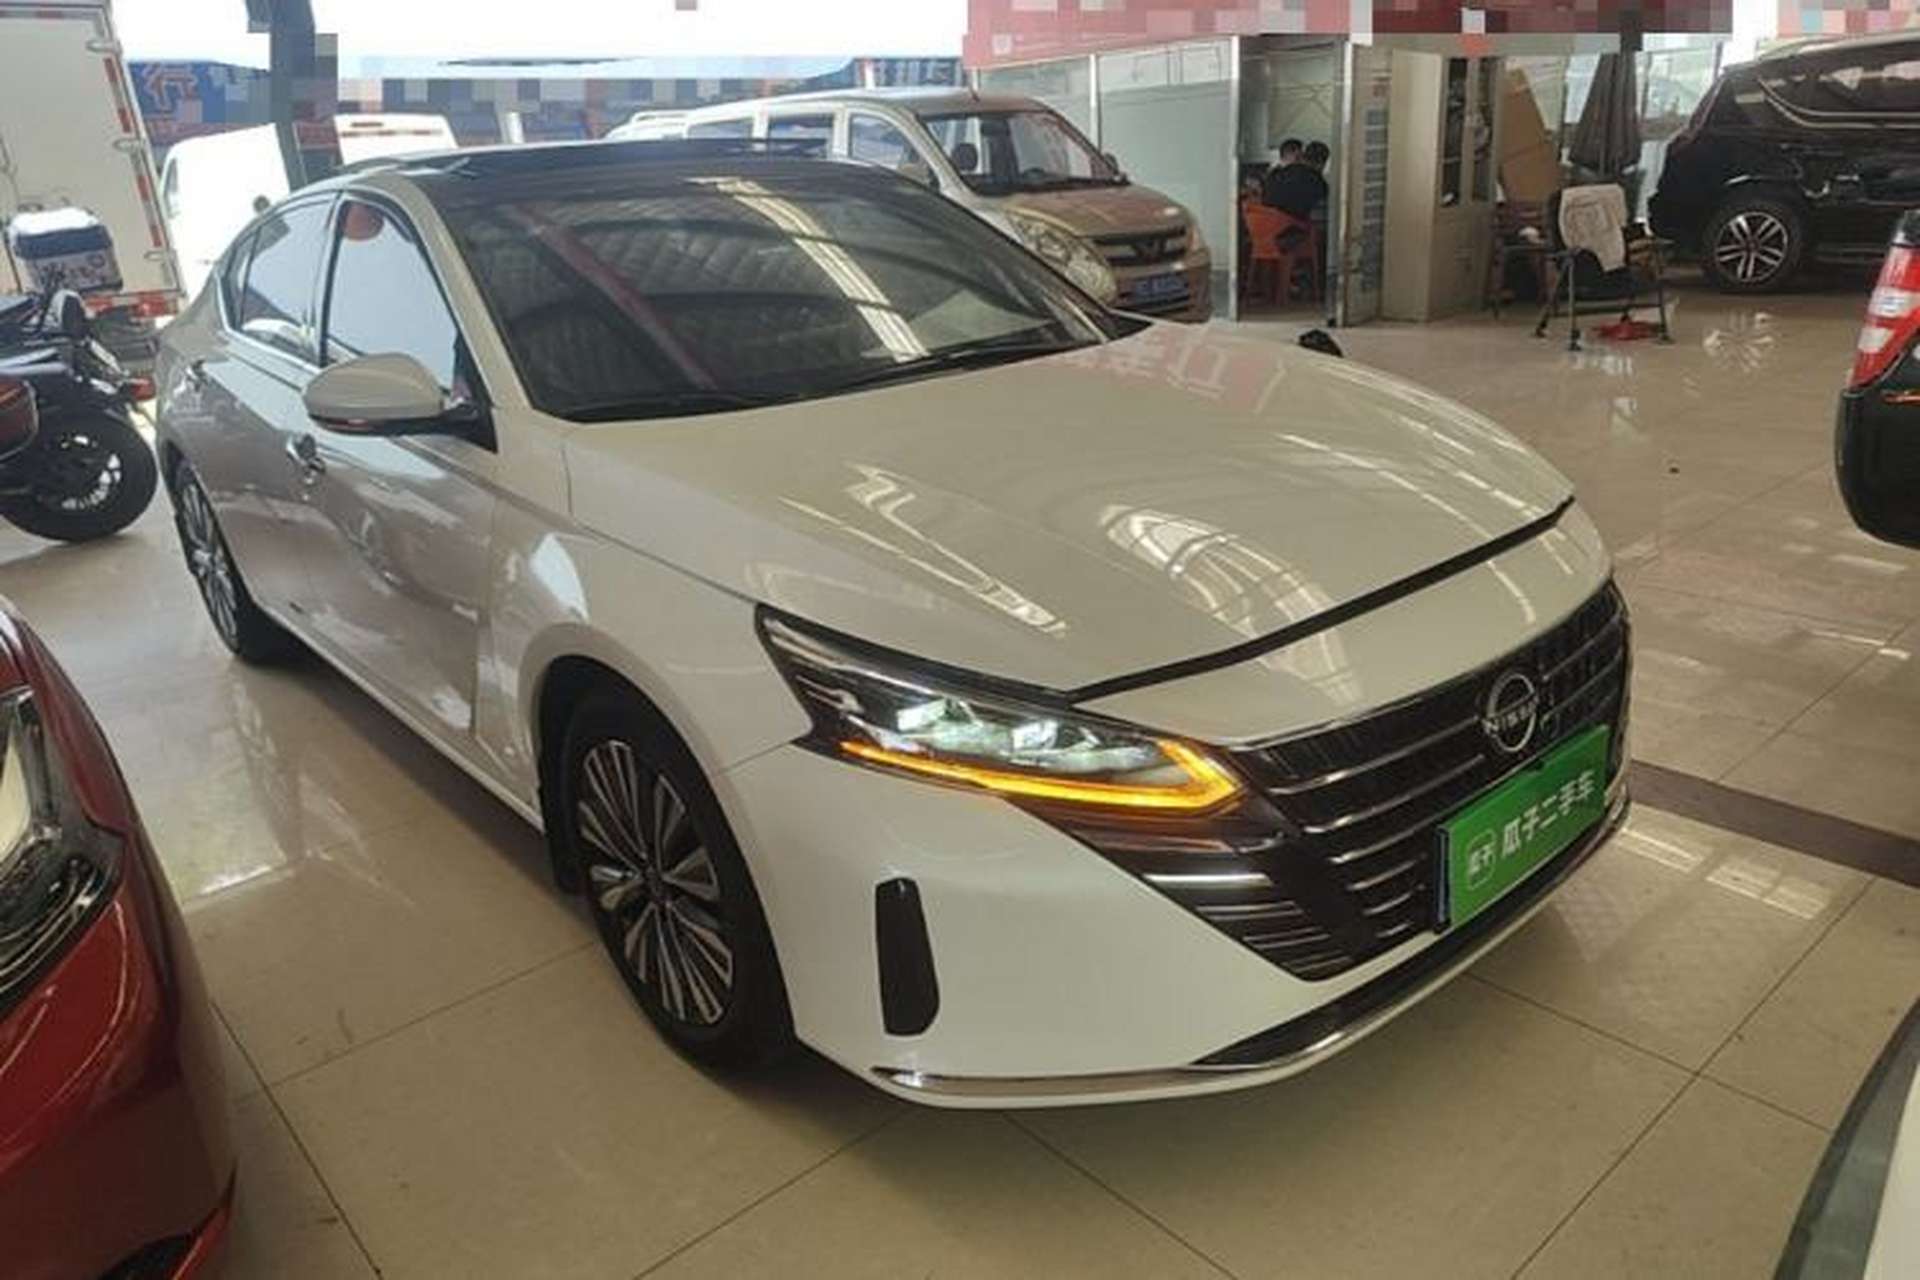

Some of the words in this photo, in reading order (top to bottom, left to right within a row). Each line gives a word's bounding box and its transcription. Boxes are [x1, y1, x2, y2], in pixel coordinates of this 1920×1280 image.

[1482, 696, 1538, 736] NISSAN
[1502, 769, 1595, 858] 瓜子二手车
